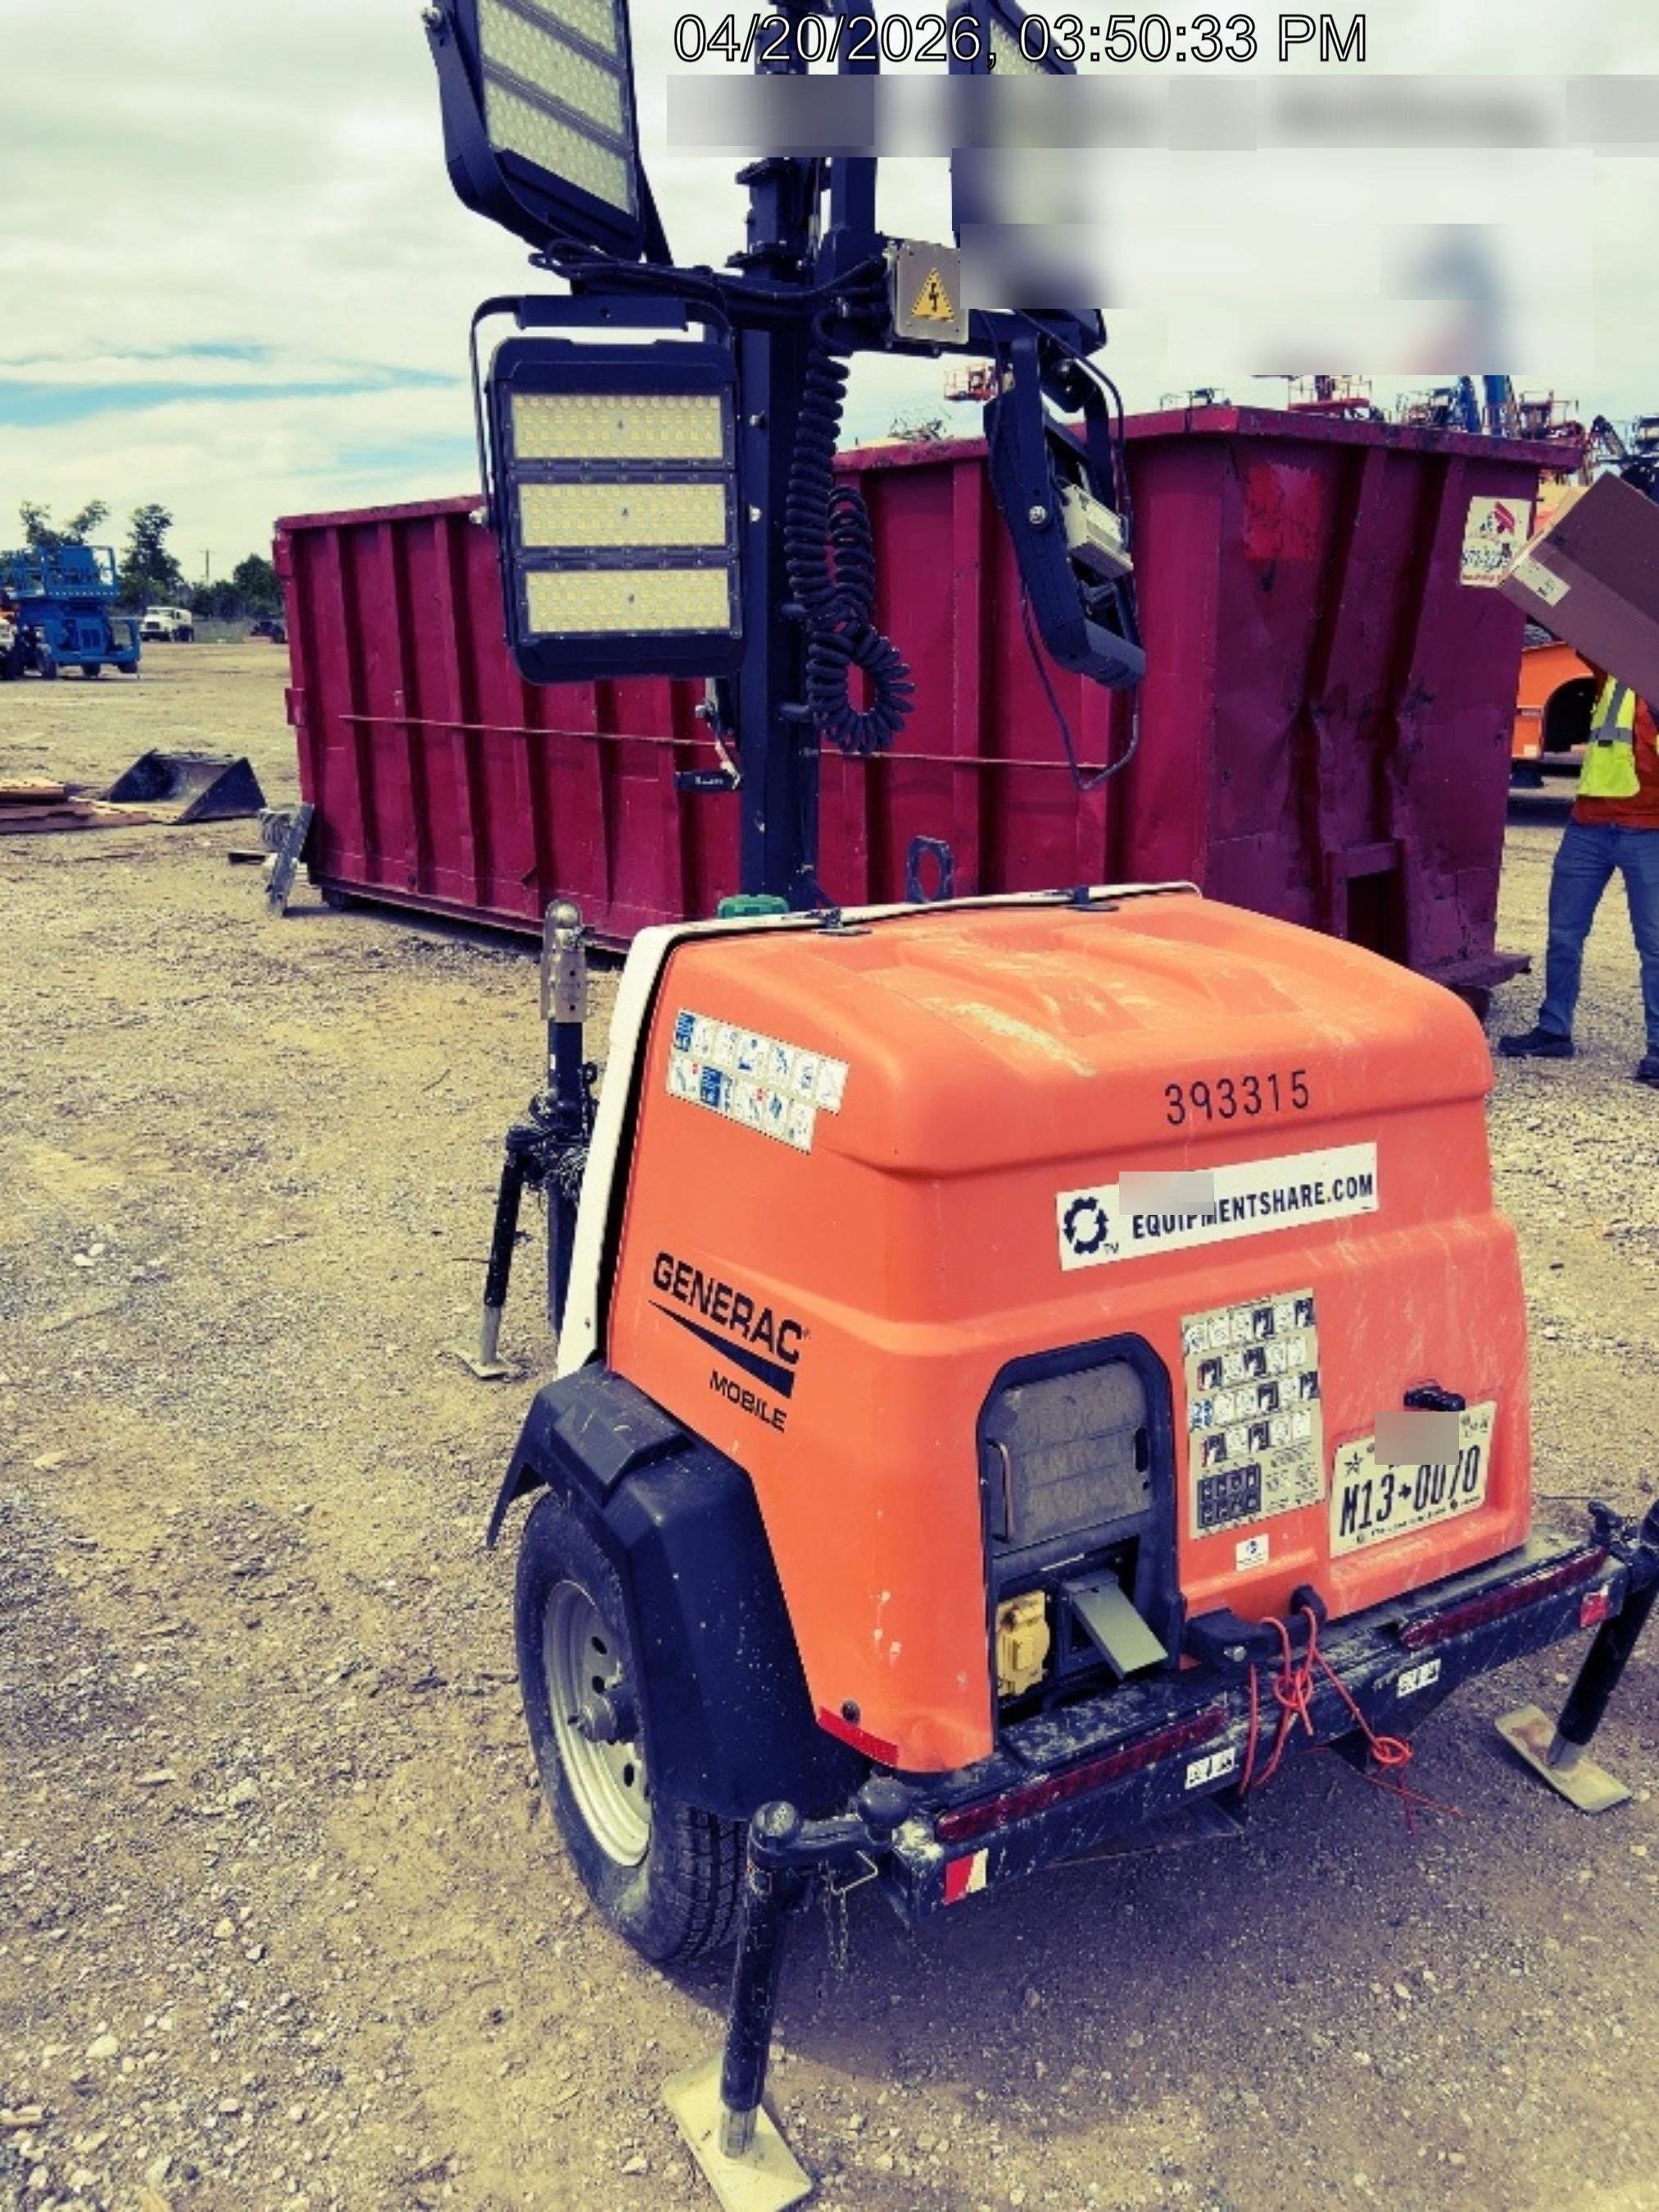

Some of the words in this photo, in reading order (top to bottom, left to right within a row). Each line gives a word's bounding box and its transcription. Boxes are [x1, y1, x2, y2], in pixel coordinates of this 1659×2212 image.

[1164, 1069, 1309, 1125] 393315
[653, 1252, 802, 1365] GENERAC
[709, 1370, 786, 1433] MOBILE
